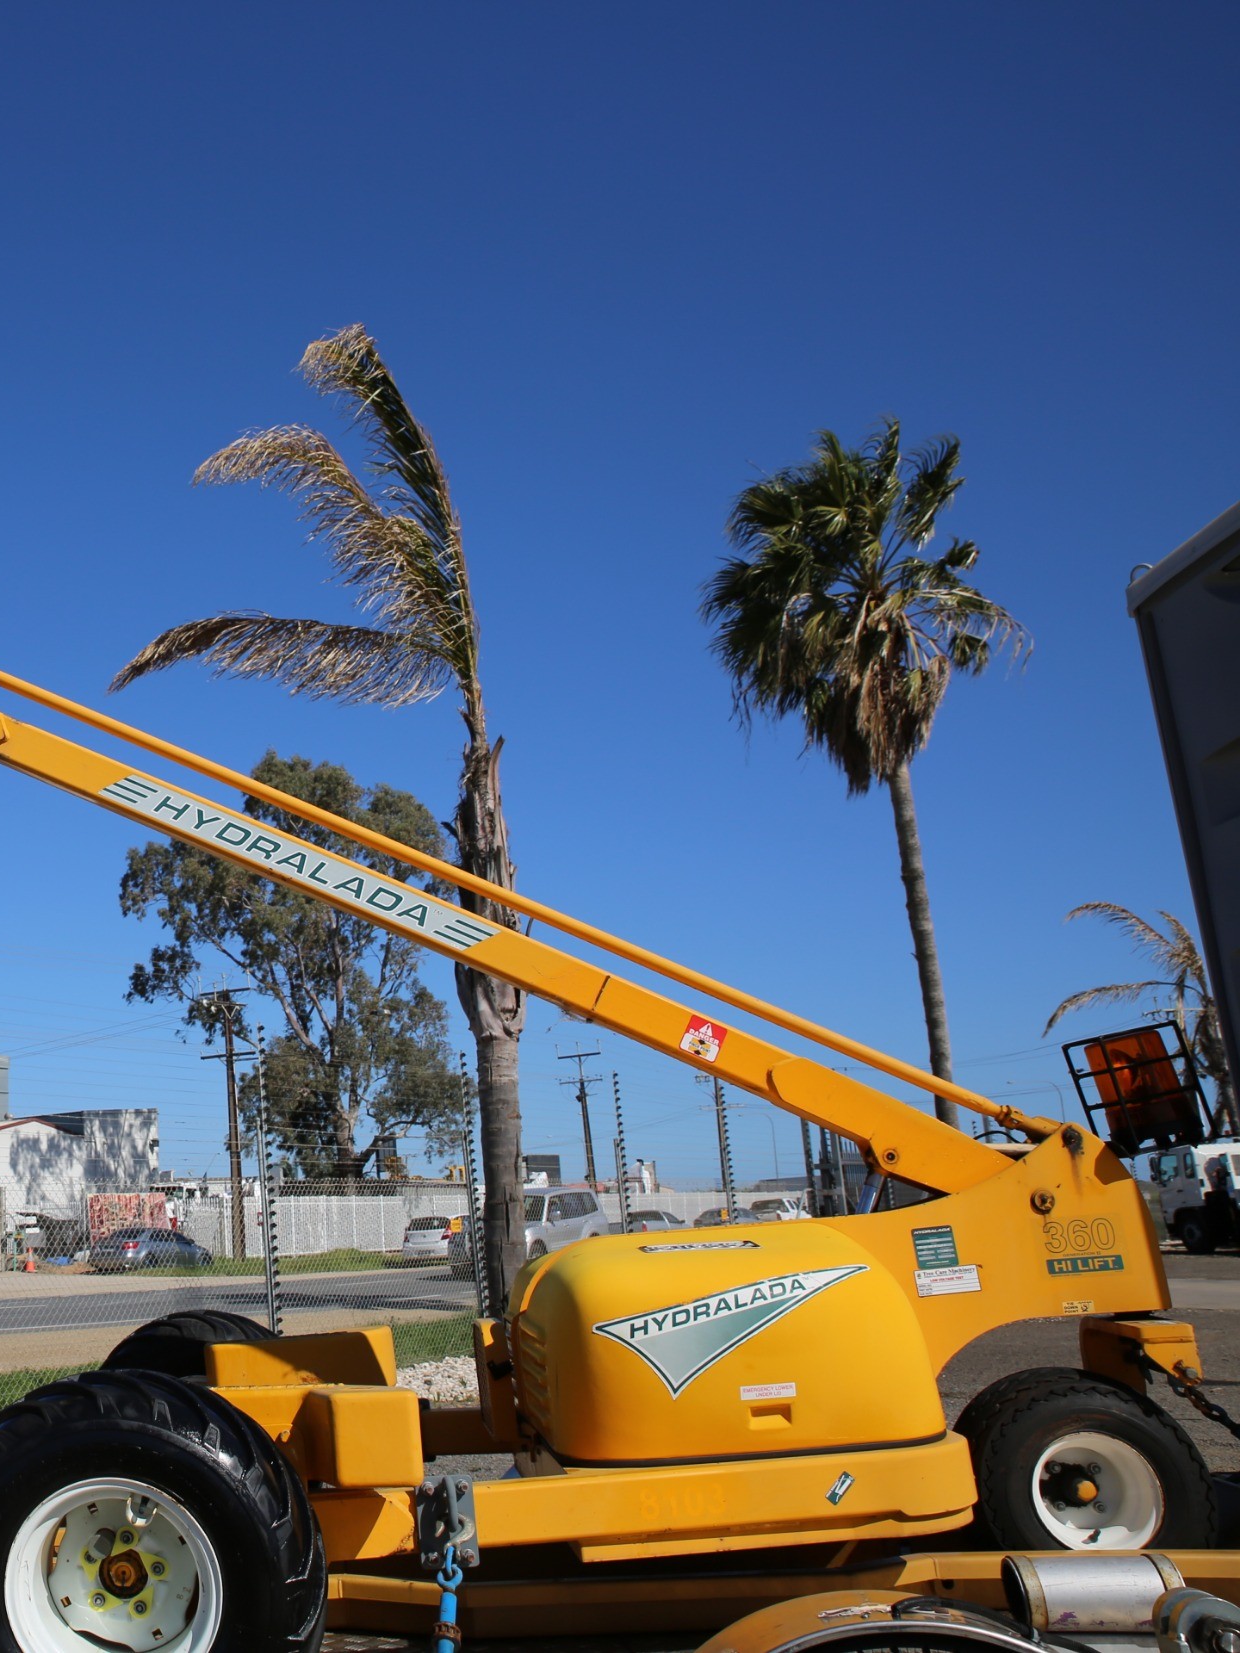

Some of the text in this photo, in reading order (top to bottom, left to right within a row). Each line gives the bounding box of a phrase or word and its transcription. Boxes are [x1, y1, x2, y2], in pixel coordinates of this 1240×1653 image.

[153, 796, 430, 927] HYDRALADA
[689, 1028, 720, 1046] DANGER
[1043, 1218, 1115, 1253] 360
[1053, 1257, 1116, 1272] HI LIFT
[630, 1278, 806, 1339] HYDRALADA
